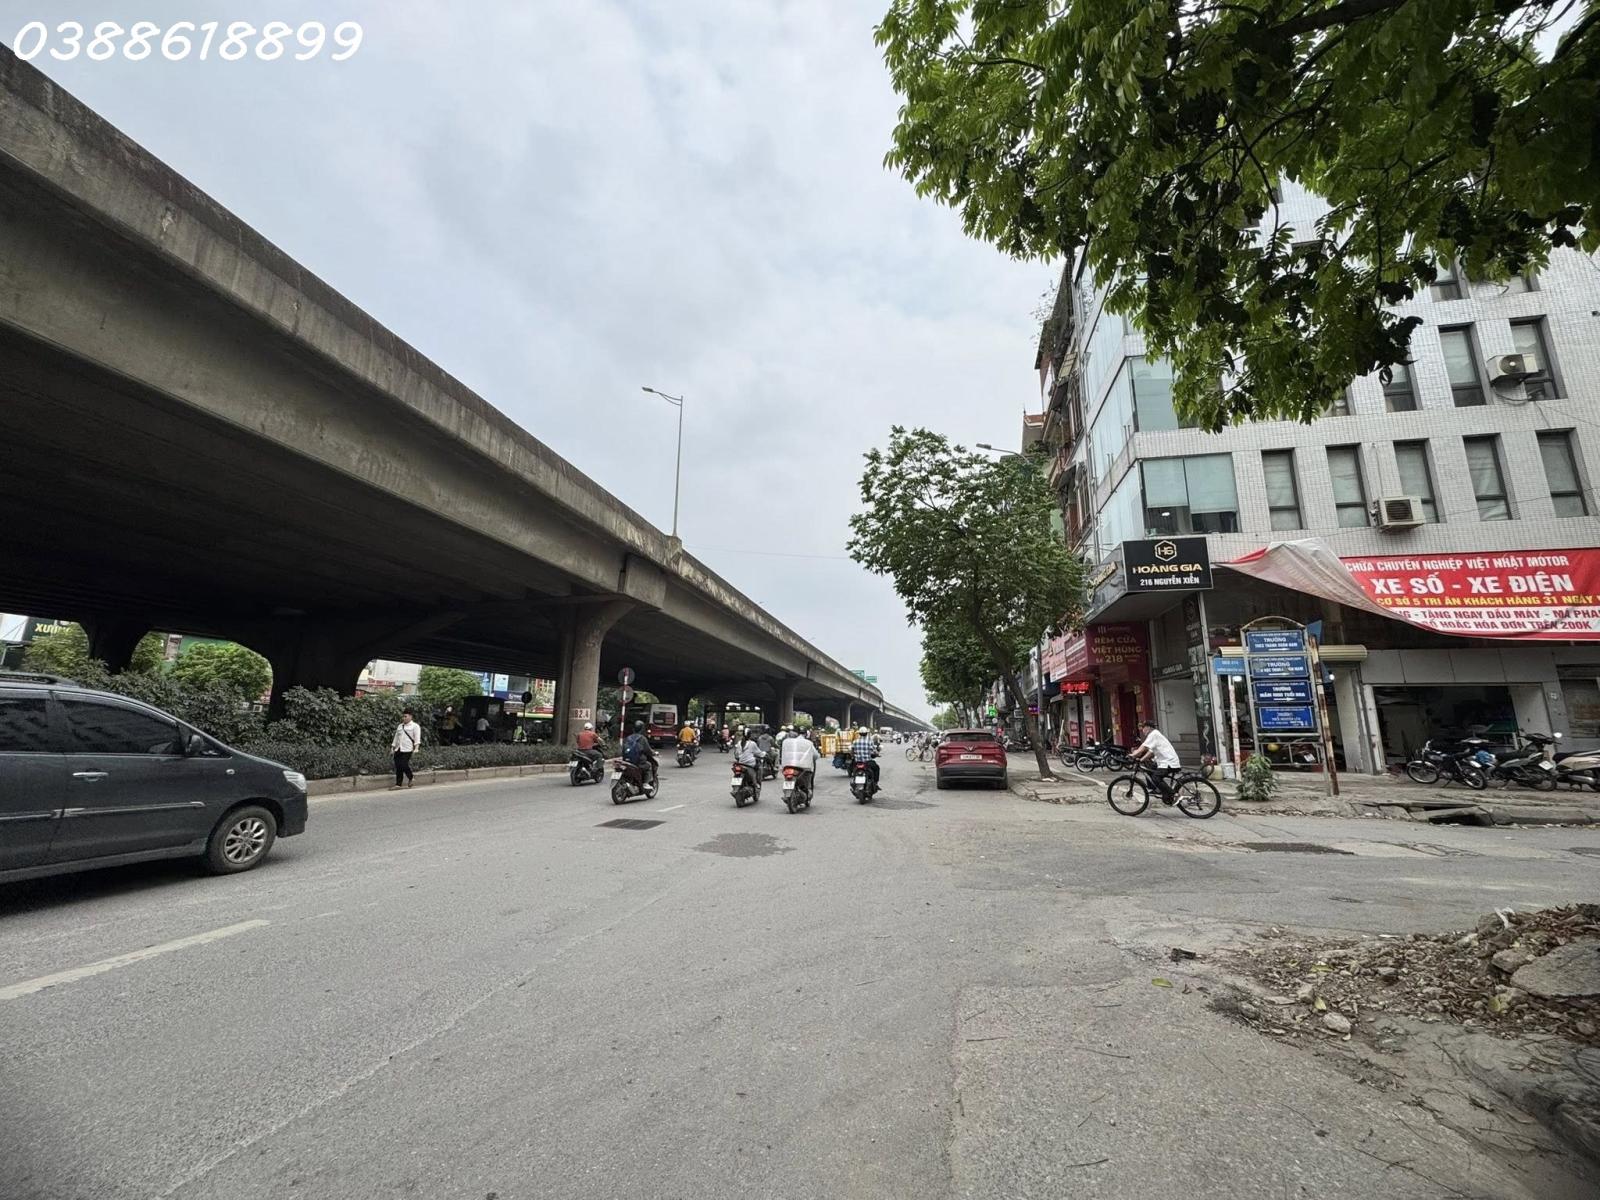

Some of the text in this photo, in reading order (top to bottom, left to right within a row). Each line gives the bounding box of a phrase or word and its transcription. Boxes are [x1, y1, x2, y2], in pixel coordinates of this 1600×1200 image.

[1132, 563, 1203, 574] HOÀNG GIA
[1377, 559, 1420, 571] CHUYÊN
[1422, 558, 1463, 571] NGHIỆP
[1466, 557, 1490, 570] VIỆT
[1493, 555, 1523, 570] NHẬT
[1154, 575, 1182, 586] NGUYỄN
[1370, 578, 1404, 594] XE
[1409, 572, 1445, 595] SỐ
[1467, 576, 1503, 594] XE
[1508, 571, 1575, 596] ĐIỆN
[1463, 596, 1505, 606] KHÁCH
[1506, 595, 1541, 605] HÀNG
[1543, 596, 1558, 604] 31
[1561, 594, 1594, 604] NGÀY
[1453, 610, 1484, 619] NGAY
[1486, 608, 1511, 619] DẦU
[1513, 608, 1540, 619] MÁY
[1573, 609, 1600, 619] PHA
[1474, 620, 1499, 630] HÓA
[1501, 620, 1527, 630] ĐƠN
[1560, 621, 1593, 630] 200K
[1105, 655, 1123, 664] 218
